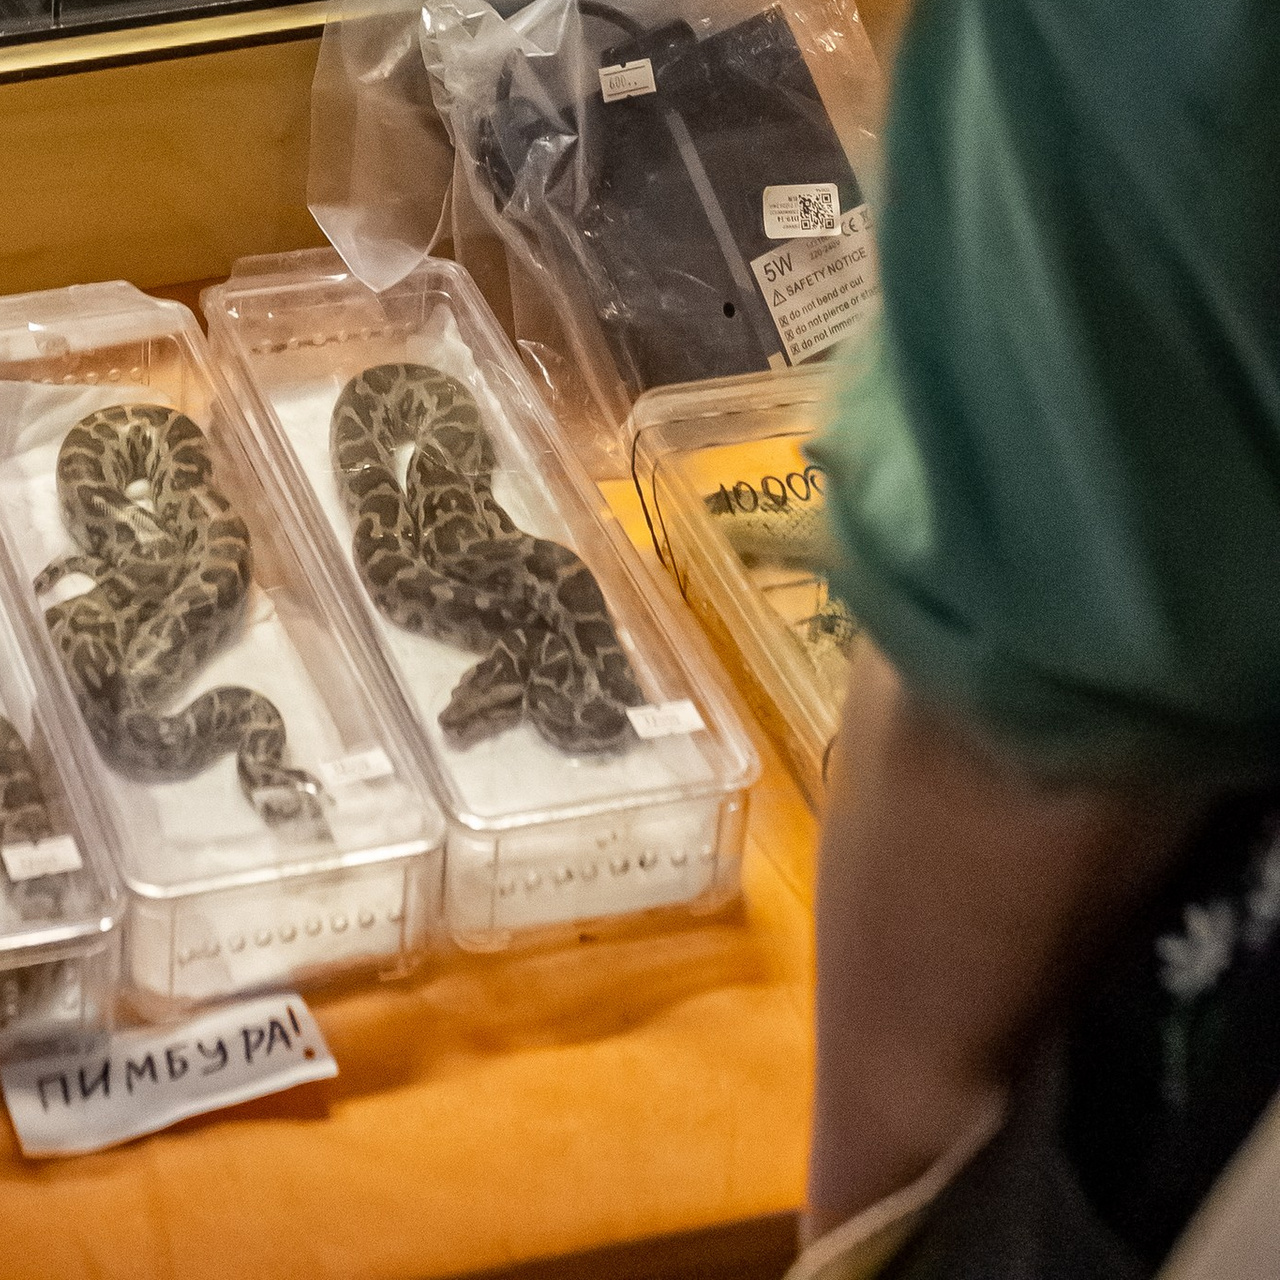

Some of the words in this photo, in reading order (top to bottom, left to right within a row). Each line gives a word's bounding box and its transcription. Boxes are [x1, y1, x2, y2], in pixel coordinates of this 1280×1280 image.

[763, 252, 793, 282] 5W
[786, 268, 826, 297] SAFETY
[826, 247, 868, 276] NOTICE
[789, 309, 801, 321] do
[801, 300, 817, 315] not
[816, 288, 839, 306] bend
[839, 283, 850, 294] or
[795, 323, 808, 335] do
[807, 314, 822, 329] not
[821, 299, 850, 322] pierce
[850, 295, 860, 307] or
[801, 338, 813, 351] do
[814, 328, 829, 344] not
[35, 1005, 317, 1112] ПИМБУРА!
